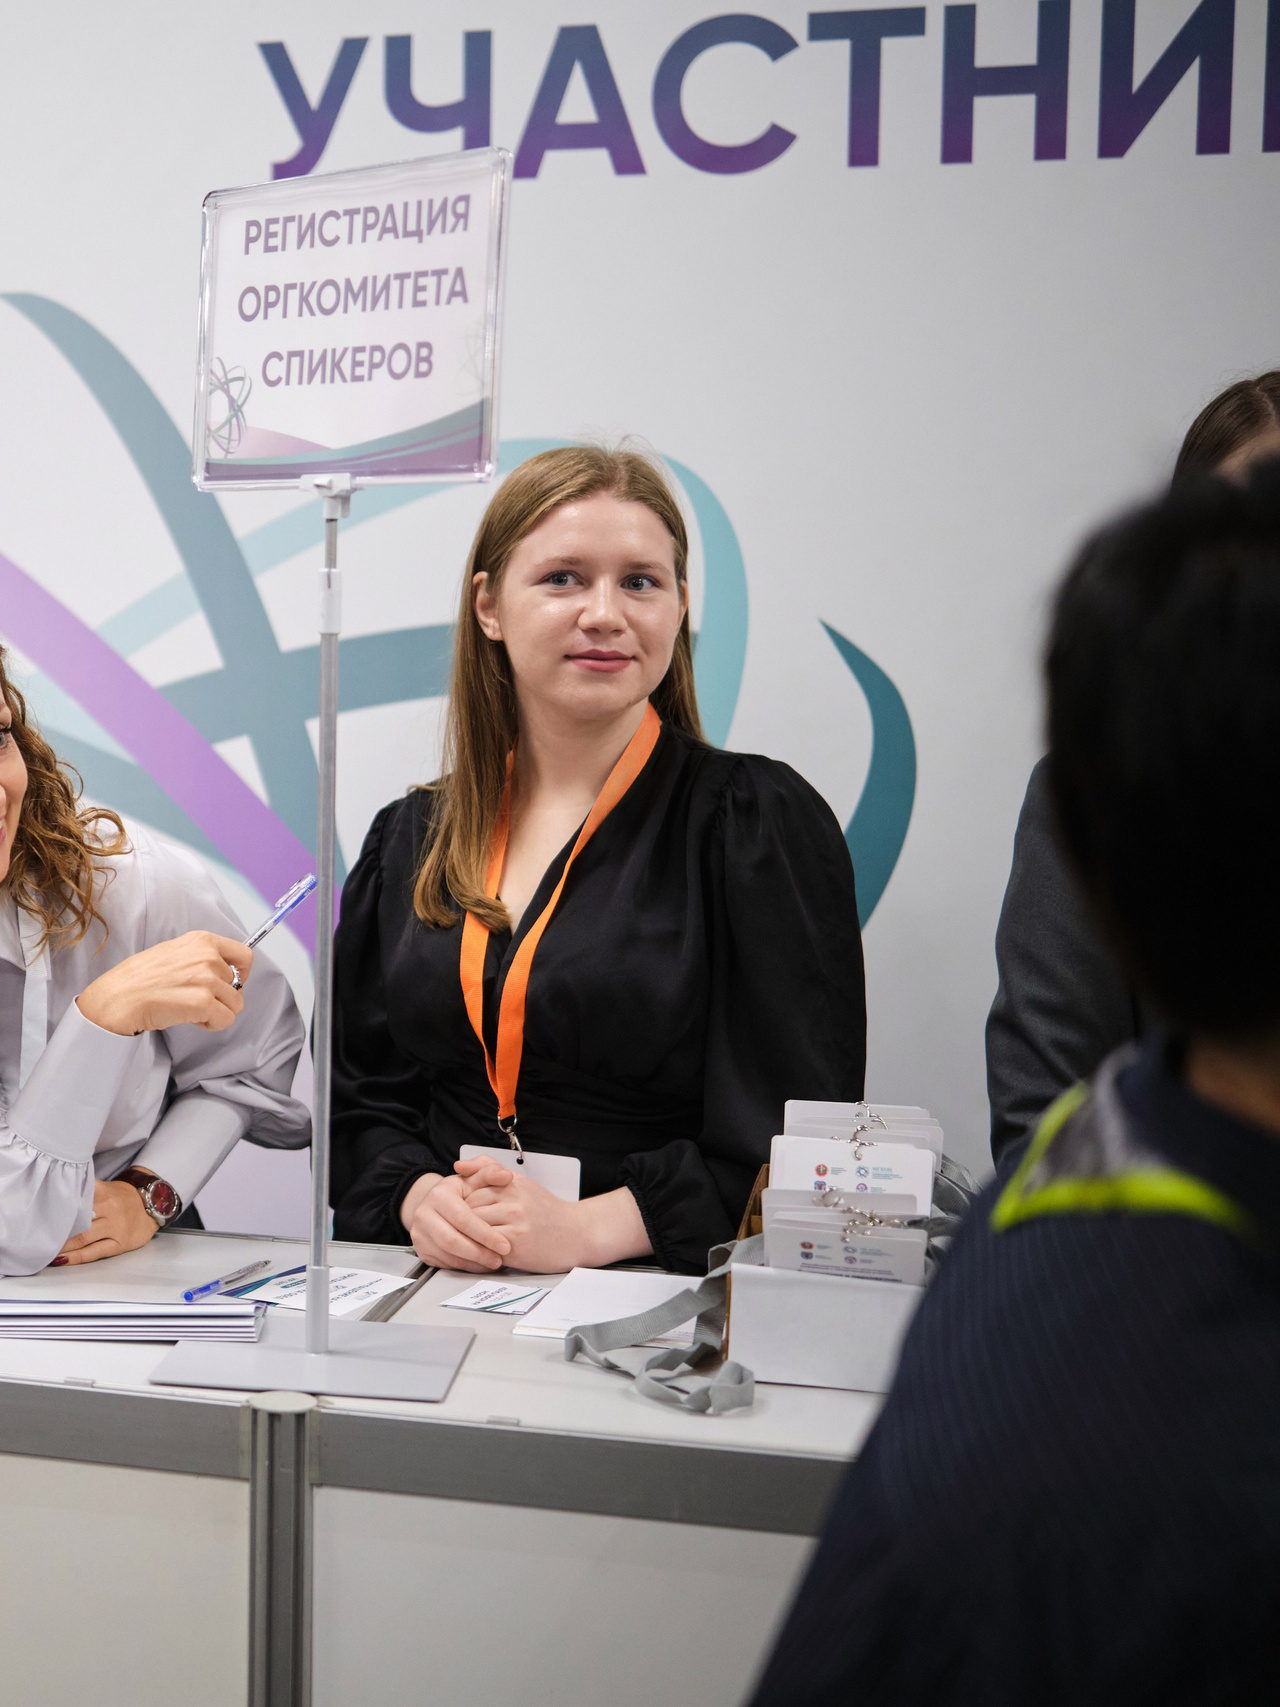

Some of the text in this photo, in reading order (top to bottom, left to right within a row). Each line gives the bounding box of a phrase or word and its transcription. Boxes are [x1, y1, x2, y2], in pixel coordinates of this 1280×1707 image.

[257, 0, 1280, 179] УЧАСТНИ
[244, 194, 471, 256] РЕГИСТРАЦИЯ
[237, 266, 469, 323] ОРГКОМИТЕТА
[261, 341, 434, 388] СПИКЕРОВ
